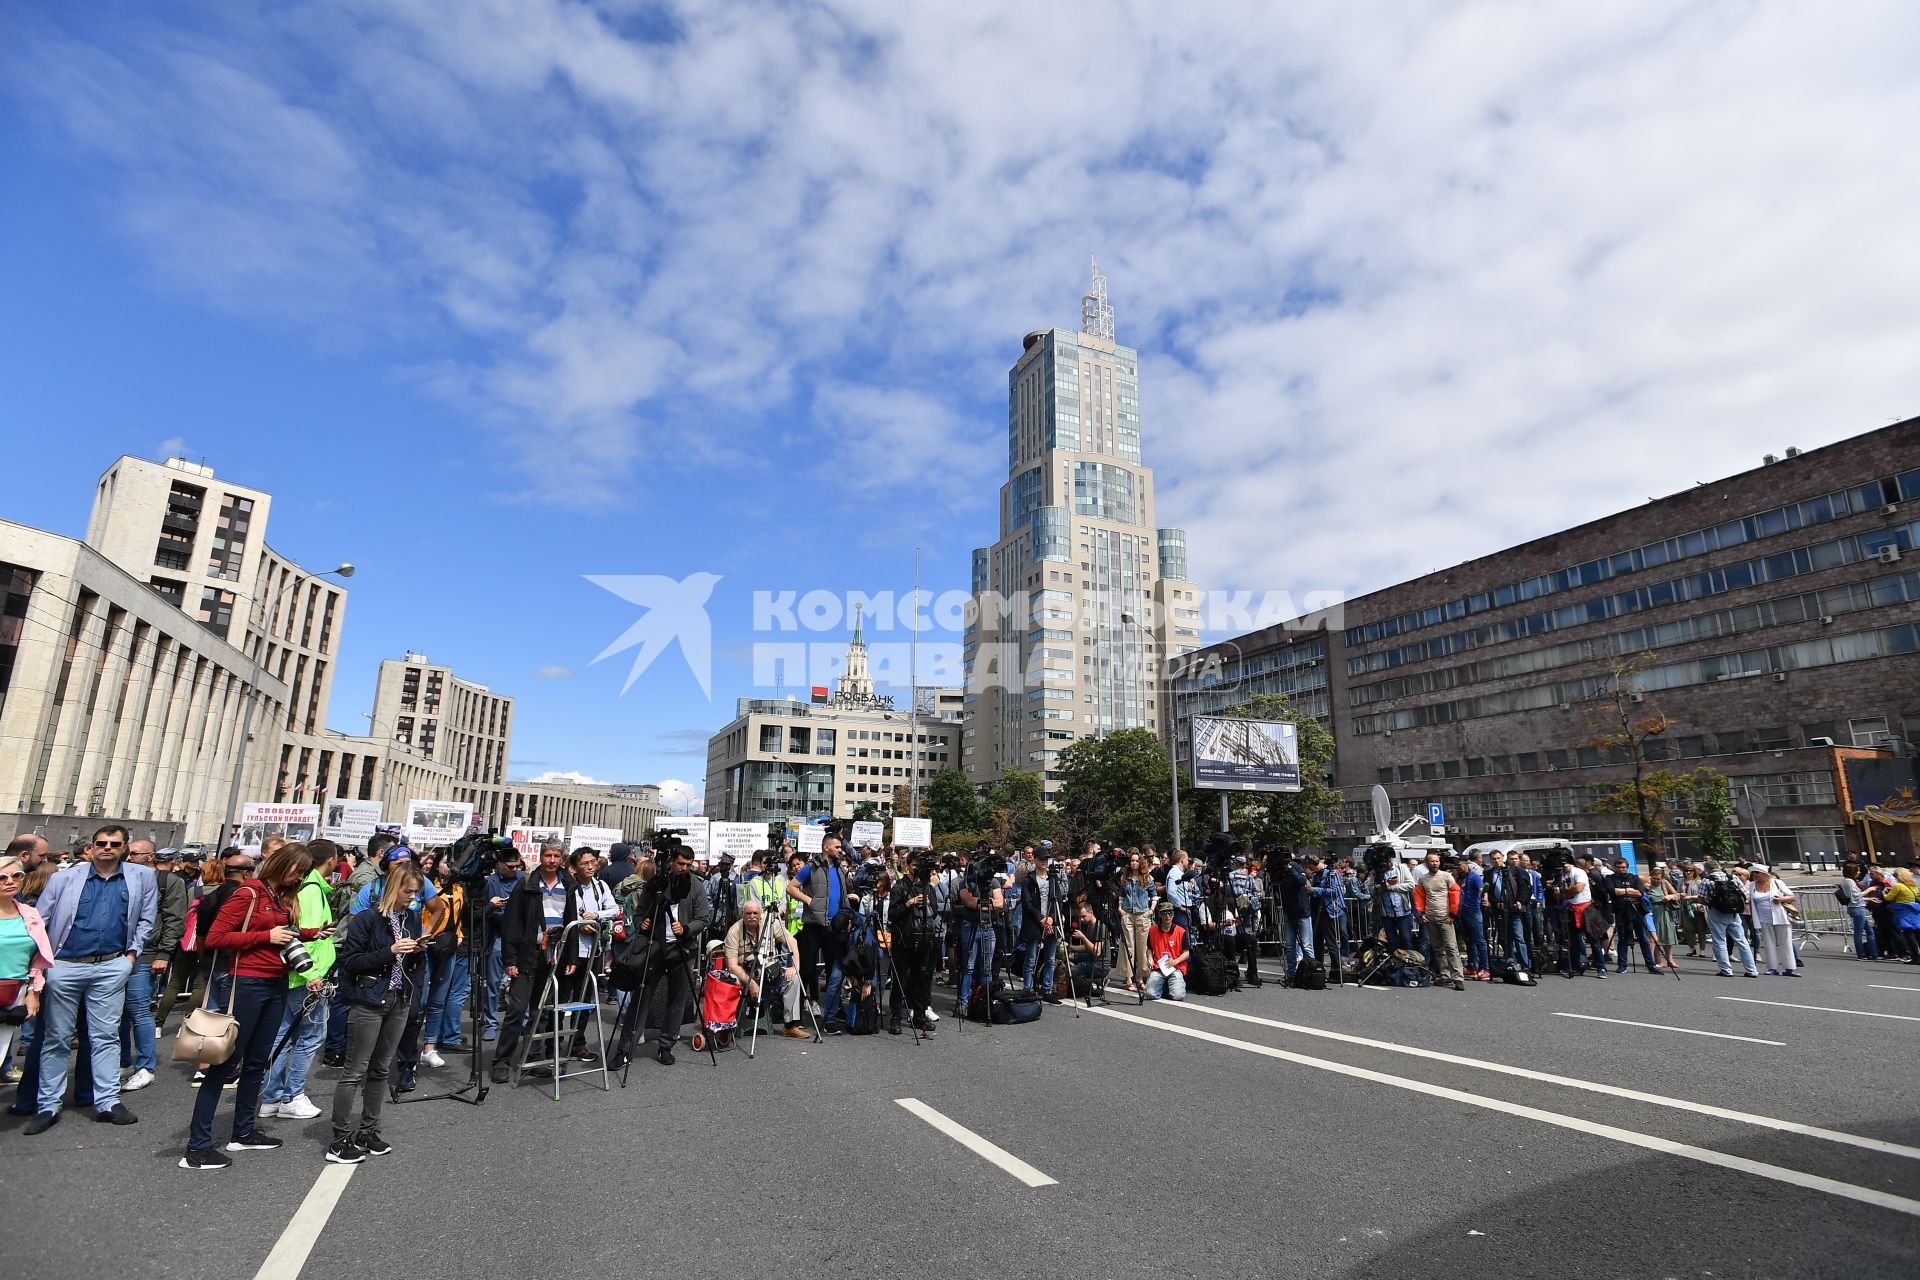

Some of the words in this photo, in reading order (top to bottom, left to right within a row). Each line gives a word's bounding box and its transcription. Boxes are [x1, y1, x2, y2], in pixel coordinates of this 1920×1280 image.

[834, 690, 895, 704] РОСБАНК
[257, 807, 304, 815] СВОБОДУ
[246, 815, 283, 823] ТУЛЬСКОЙ
[284, 816, 314, 824] ПРАВДЕ!
